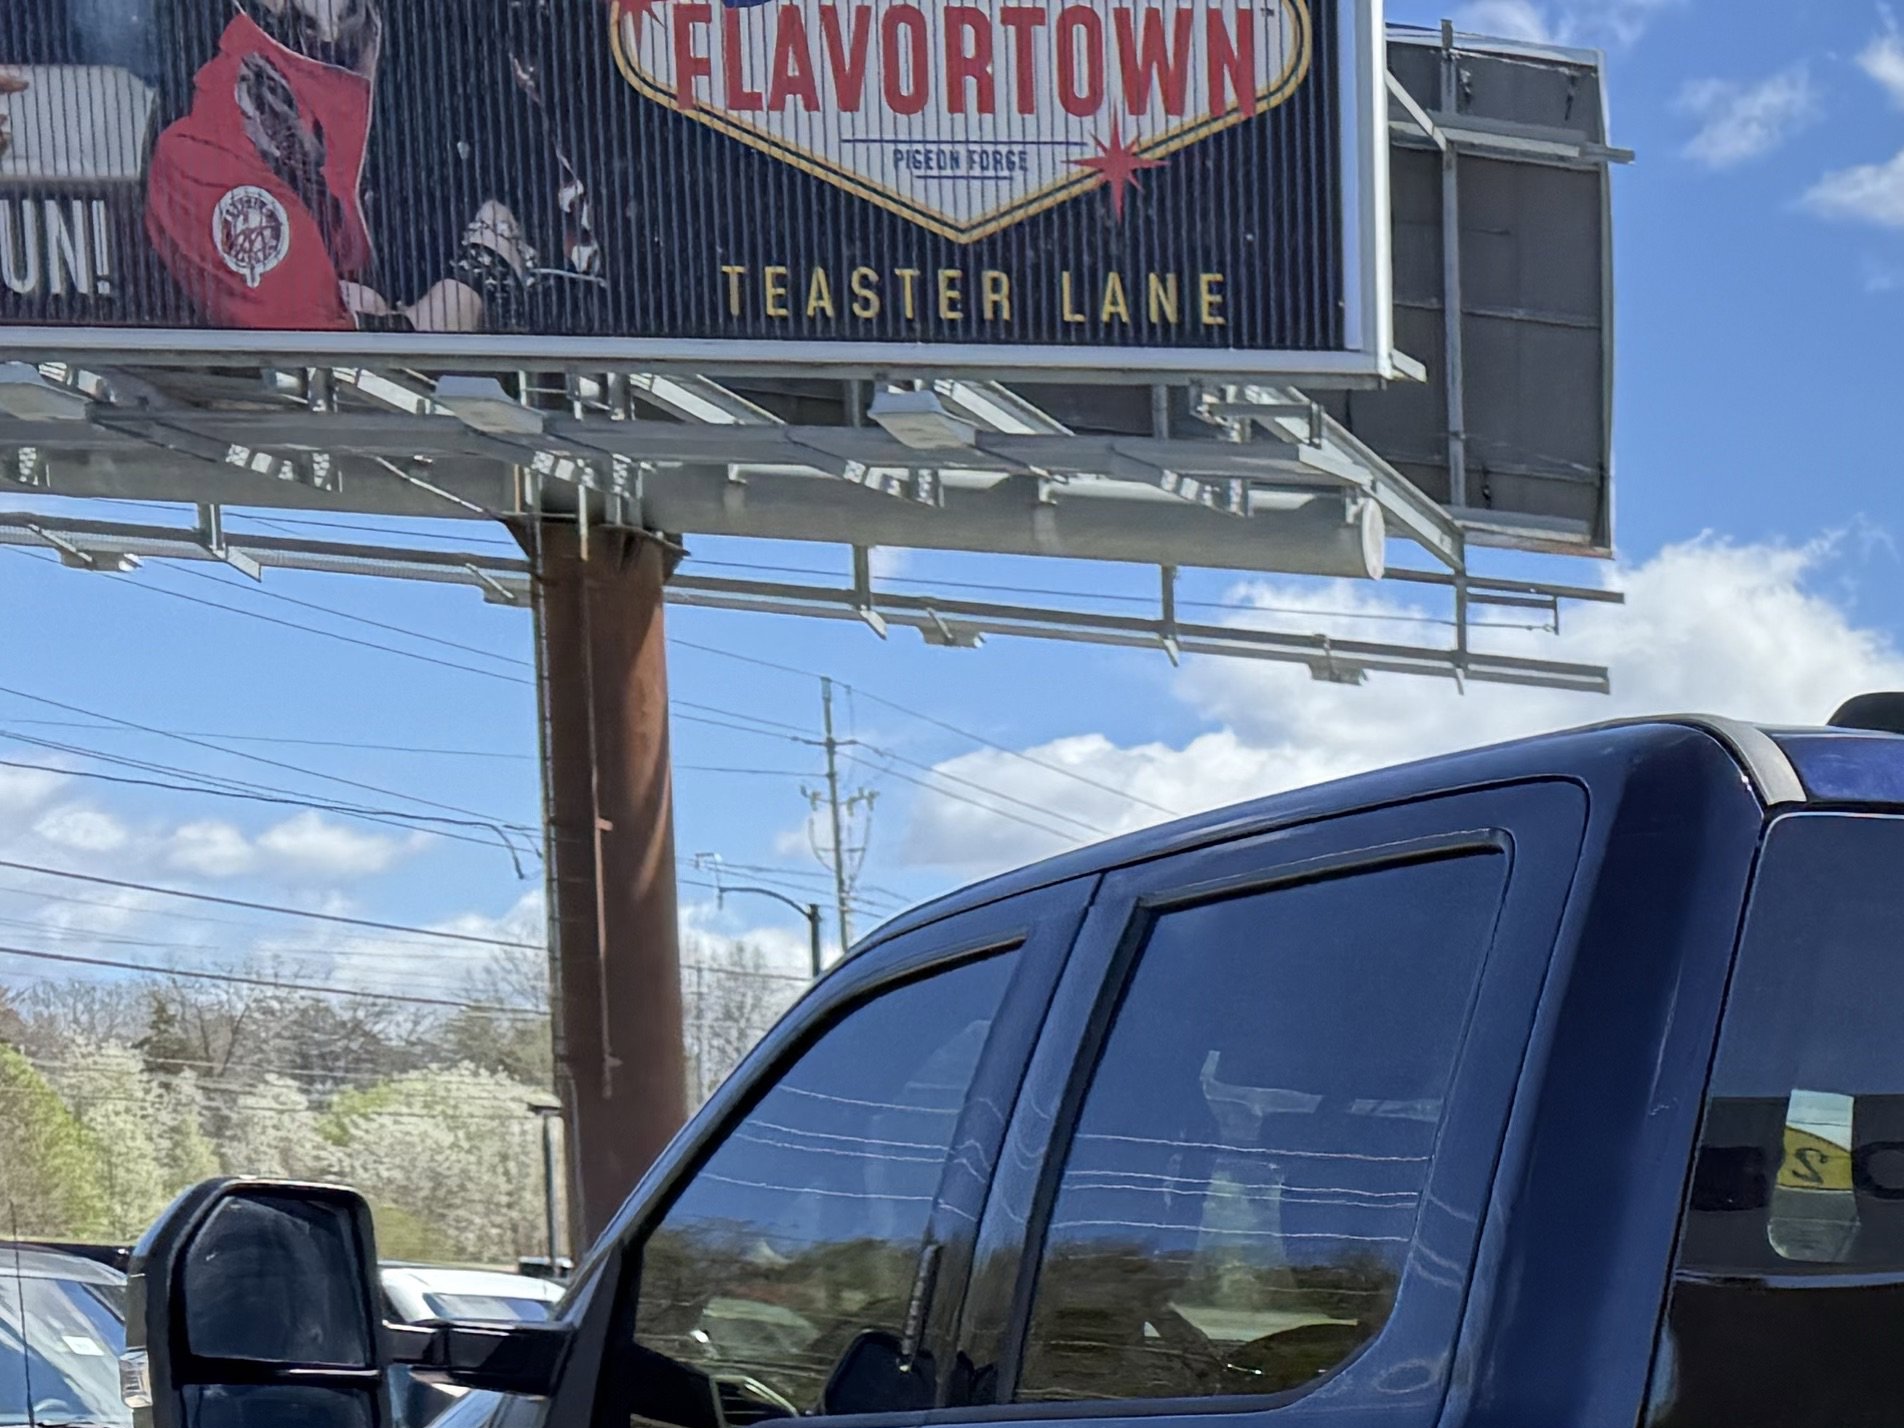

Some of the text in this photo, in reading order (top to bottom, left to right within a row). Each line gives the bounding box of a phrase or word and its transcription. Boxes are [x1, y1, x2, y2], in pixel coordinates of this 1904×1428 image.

[674, 4, 1257, 119] FLAVORTOWN
[893, 148, 1028, 172] PIGEON FORGE
[721, 265, 1228, 326] TEASTER LANE
